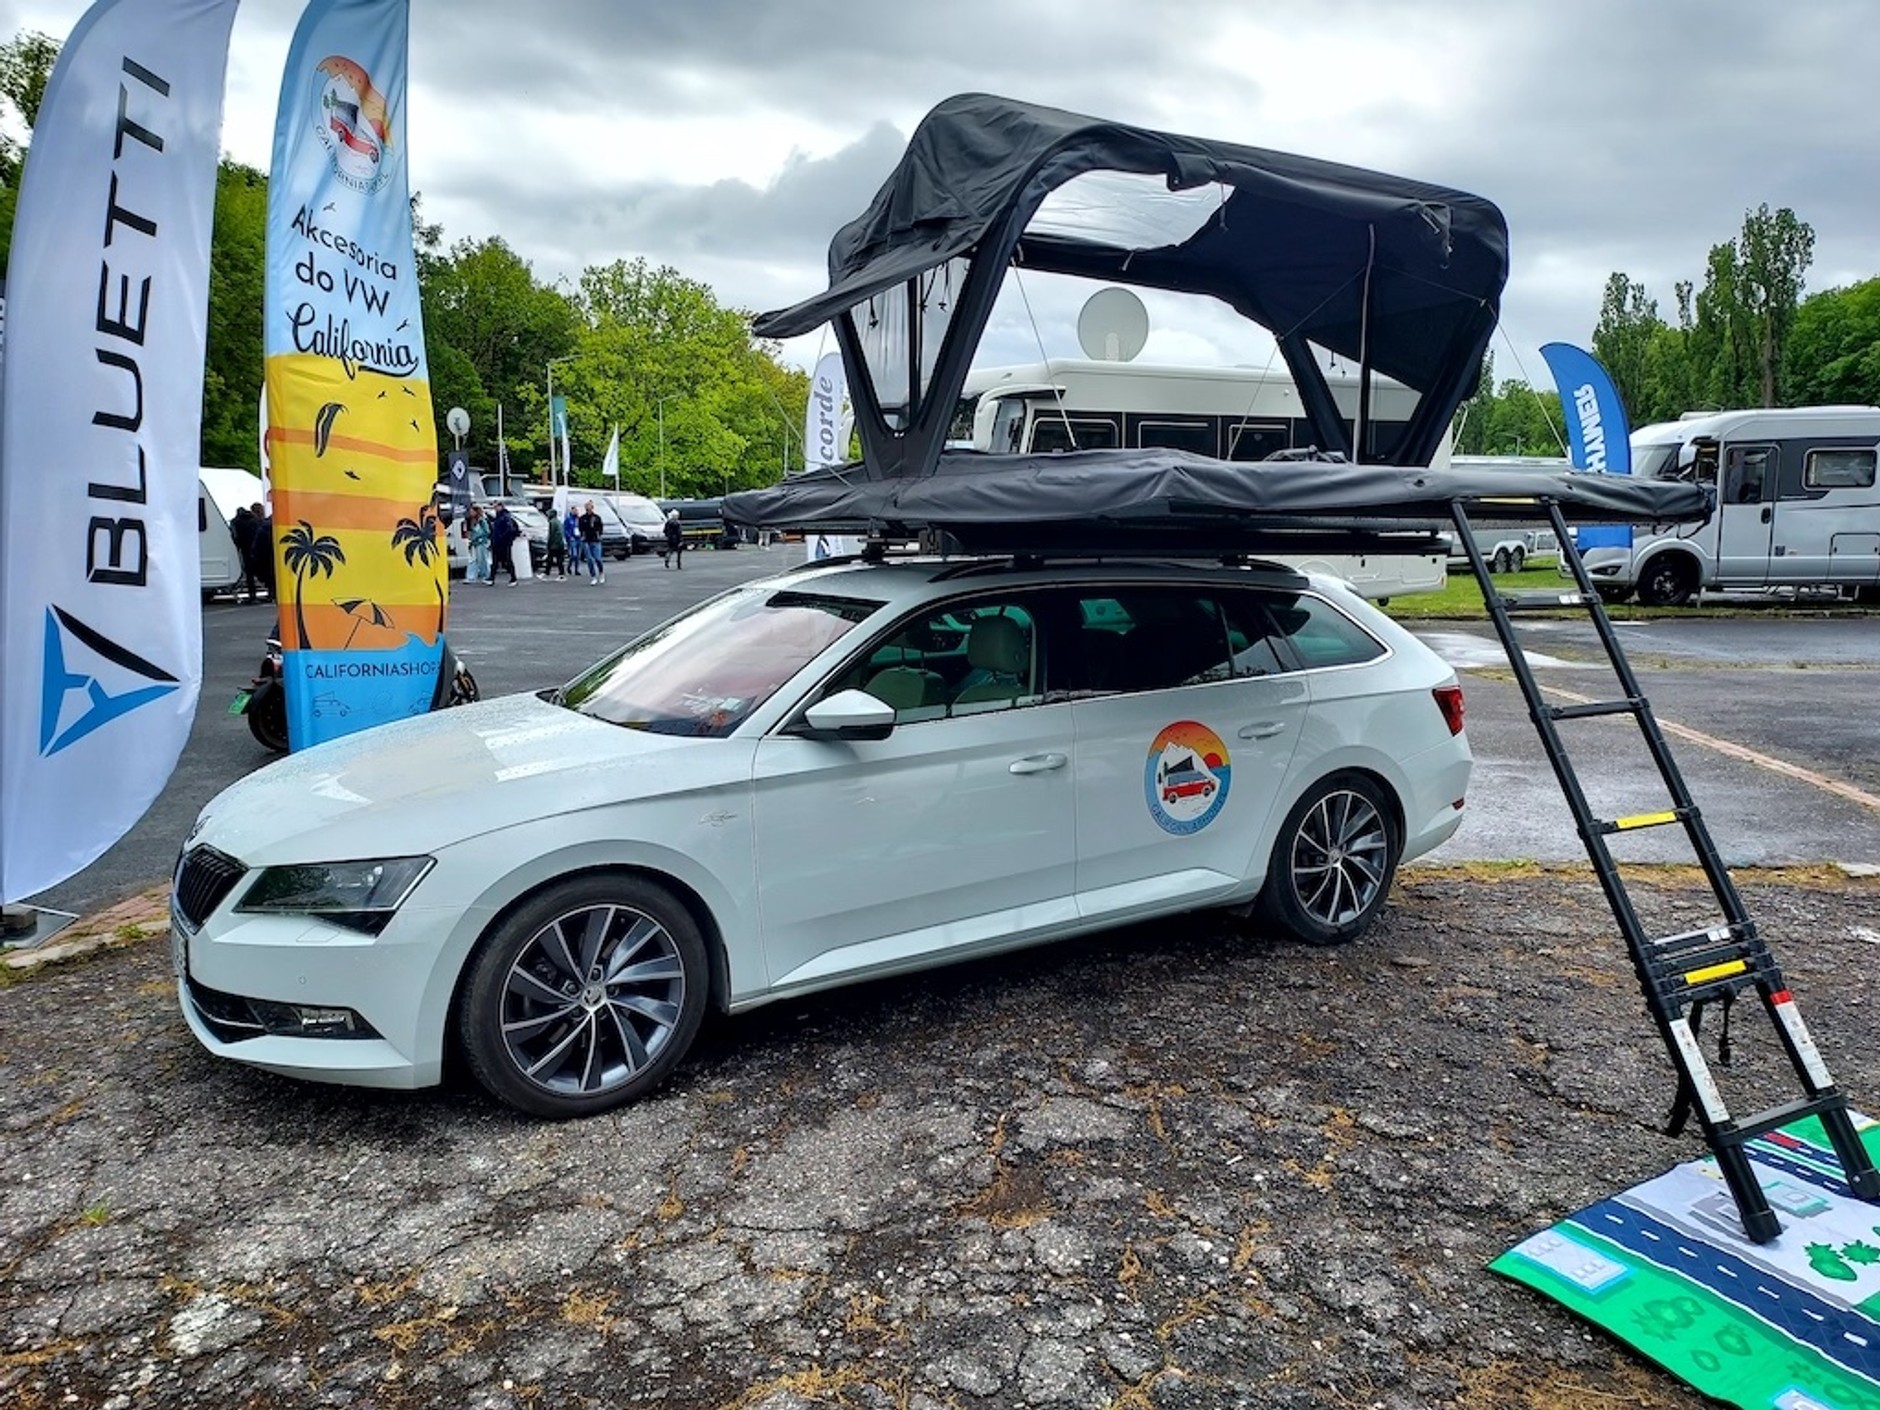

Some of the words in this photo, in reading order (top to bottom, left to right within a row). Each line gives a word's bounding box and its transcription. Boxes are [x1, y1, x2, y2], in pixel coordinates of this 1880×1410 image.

[291, 205, 397, 281] Akcesoria
[87, 56, 170, 587] BLUETTI
[295, 252, 333, 293] do
[344, 269, 390, 317] VW
[286, 303, 418, 380] California
